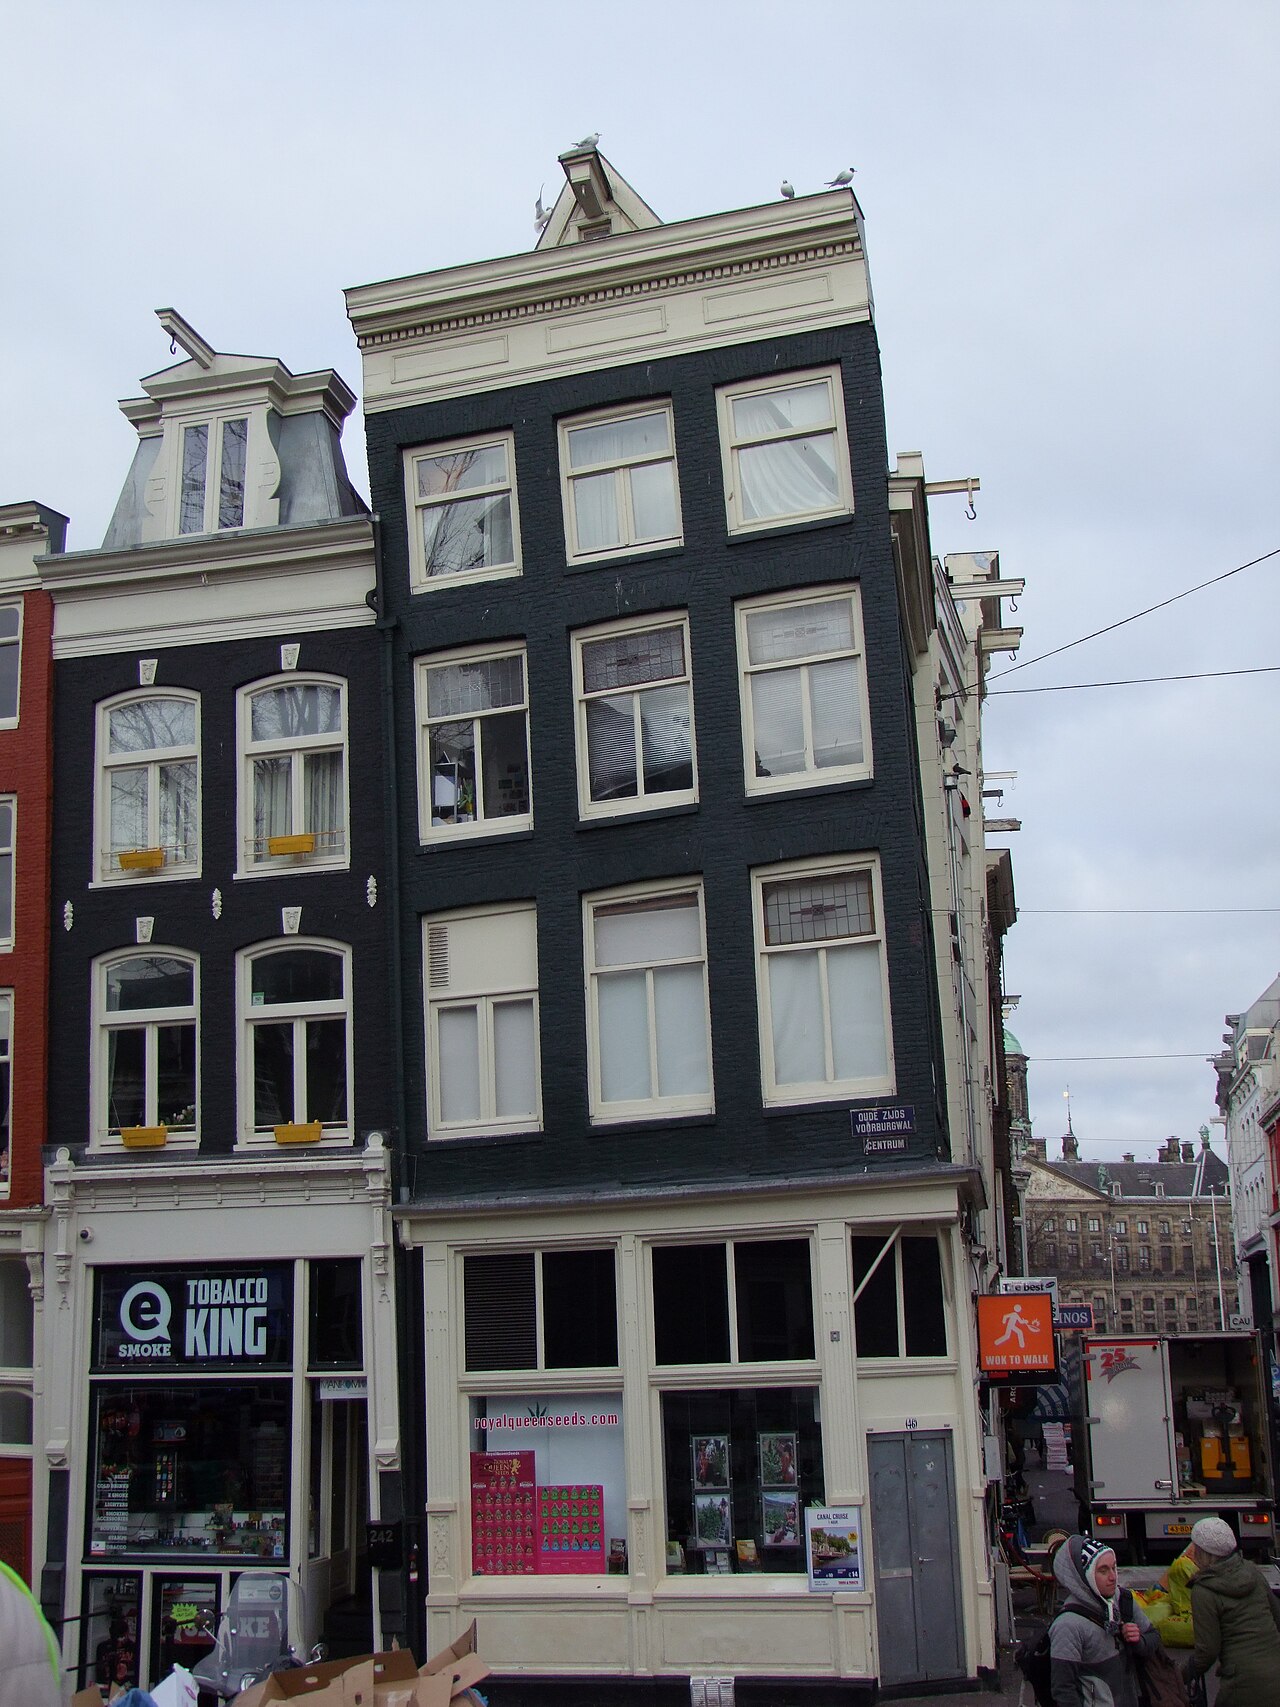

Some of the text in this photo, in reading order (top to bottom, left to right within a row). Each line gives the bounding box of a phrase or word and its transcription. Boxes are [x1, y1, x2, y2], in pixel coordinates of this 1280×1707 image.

[858, 1109, 905, 1122] OUDE ZIJDS
[855, 1120, 913, 1133] VOORBURGWAL
[866, 1139, 905, 1151] CENTRUM
[187, 1278, 268, 1305] TOBACCO
[1023, 1282, 1044, 1292] best
[1054, 1311, 1088, 1324] INOS
[185, 1306, 267, 1356] KING
[118, 1343, 171, 1358] SMOKE
[985, 1354, 1049, 1366] WOK TO WALK
[1100, 1347, 1126, 1369] 25
[474, 1411, 618, 1431] royalqueenseeds.com
[832, 1512, 849, 1520] CRUISE
[369, 1530, 394, 1543] 242
